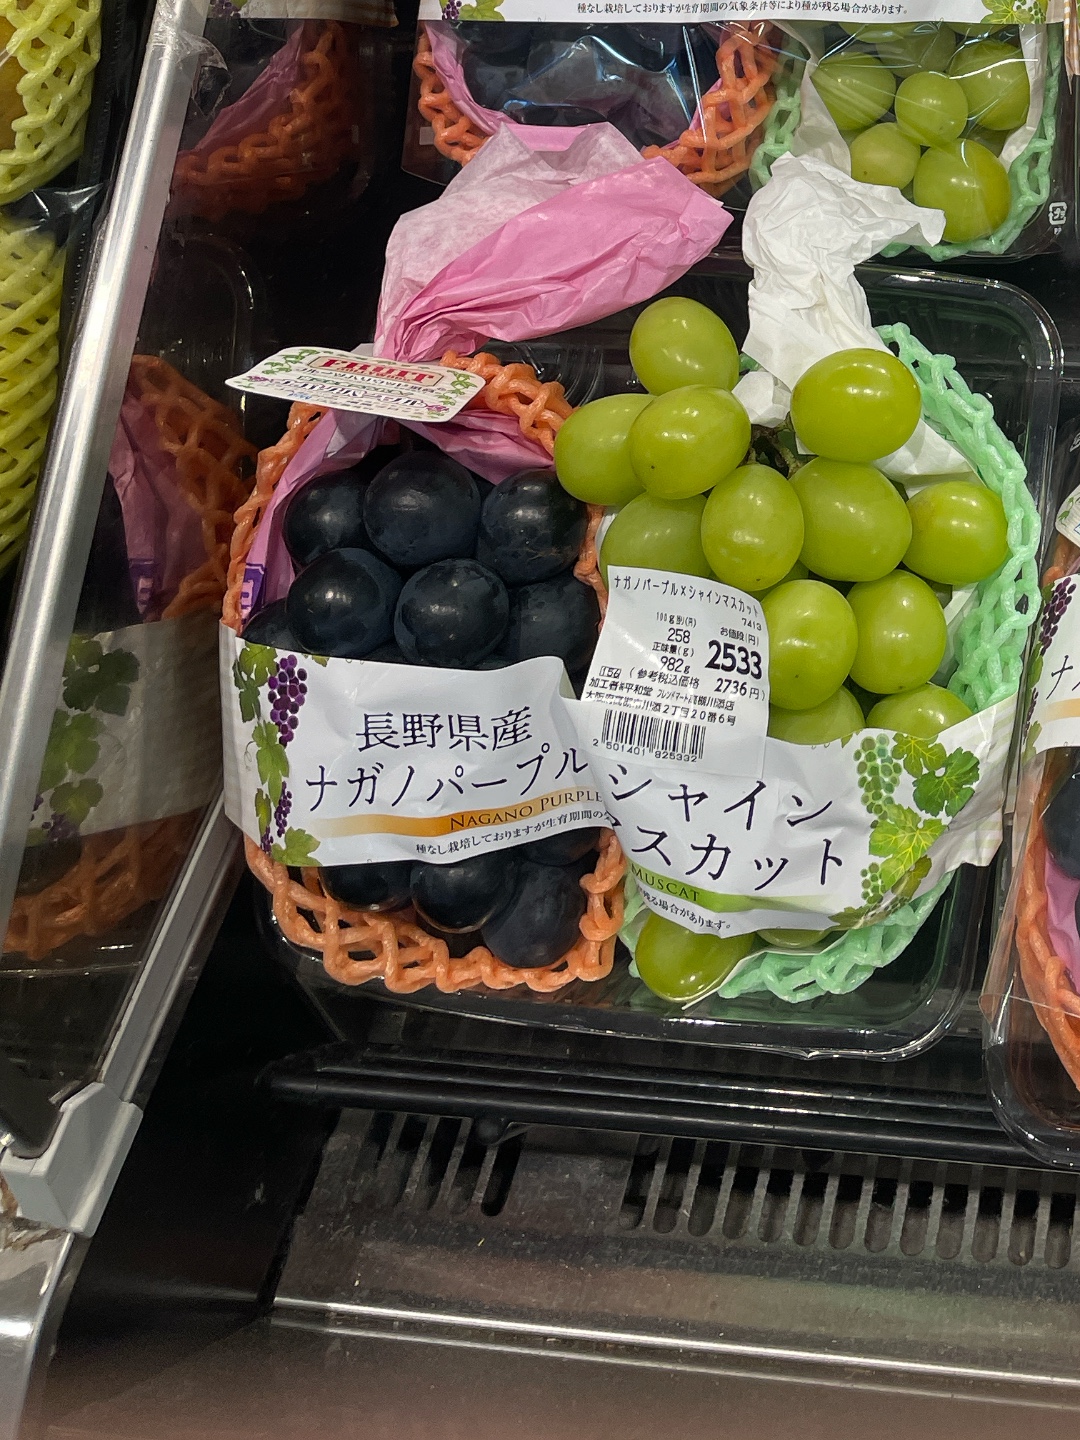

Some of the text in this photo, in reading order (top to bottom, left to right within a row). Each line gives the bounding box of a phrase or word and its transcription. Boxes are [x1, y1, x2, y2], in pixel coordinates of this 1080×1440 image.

[741, 617, 762, 631] 7413
[667, 627, 762, 680] 258 2533
[356, 706, 533, 752] 長野県産
[605, 741, 698, 763] 501401 825332
[305, 742, 589, 812] ナガノパープル
[608, 764, 833, 831] シャイン
[450, 787, 603, 831] NAGANO PURPLE
[631, 863, 700, 902] MUSCAT
